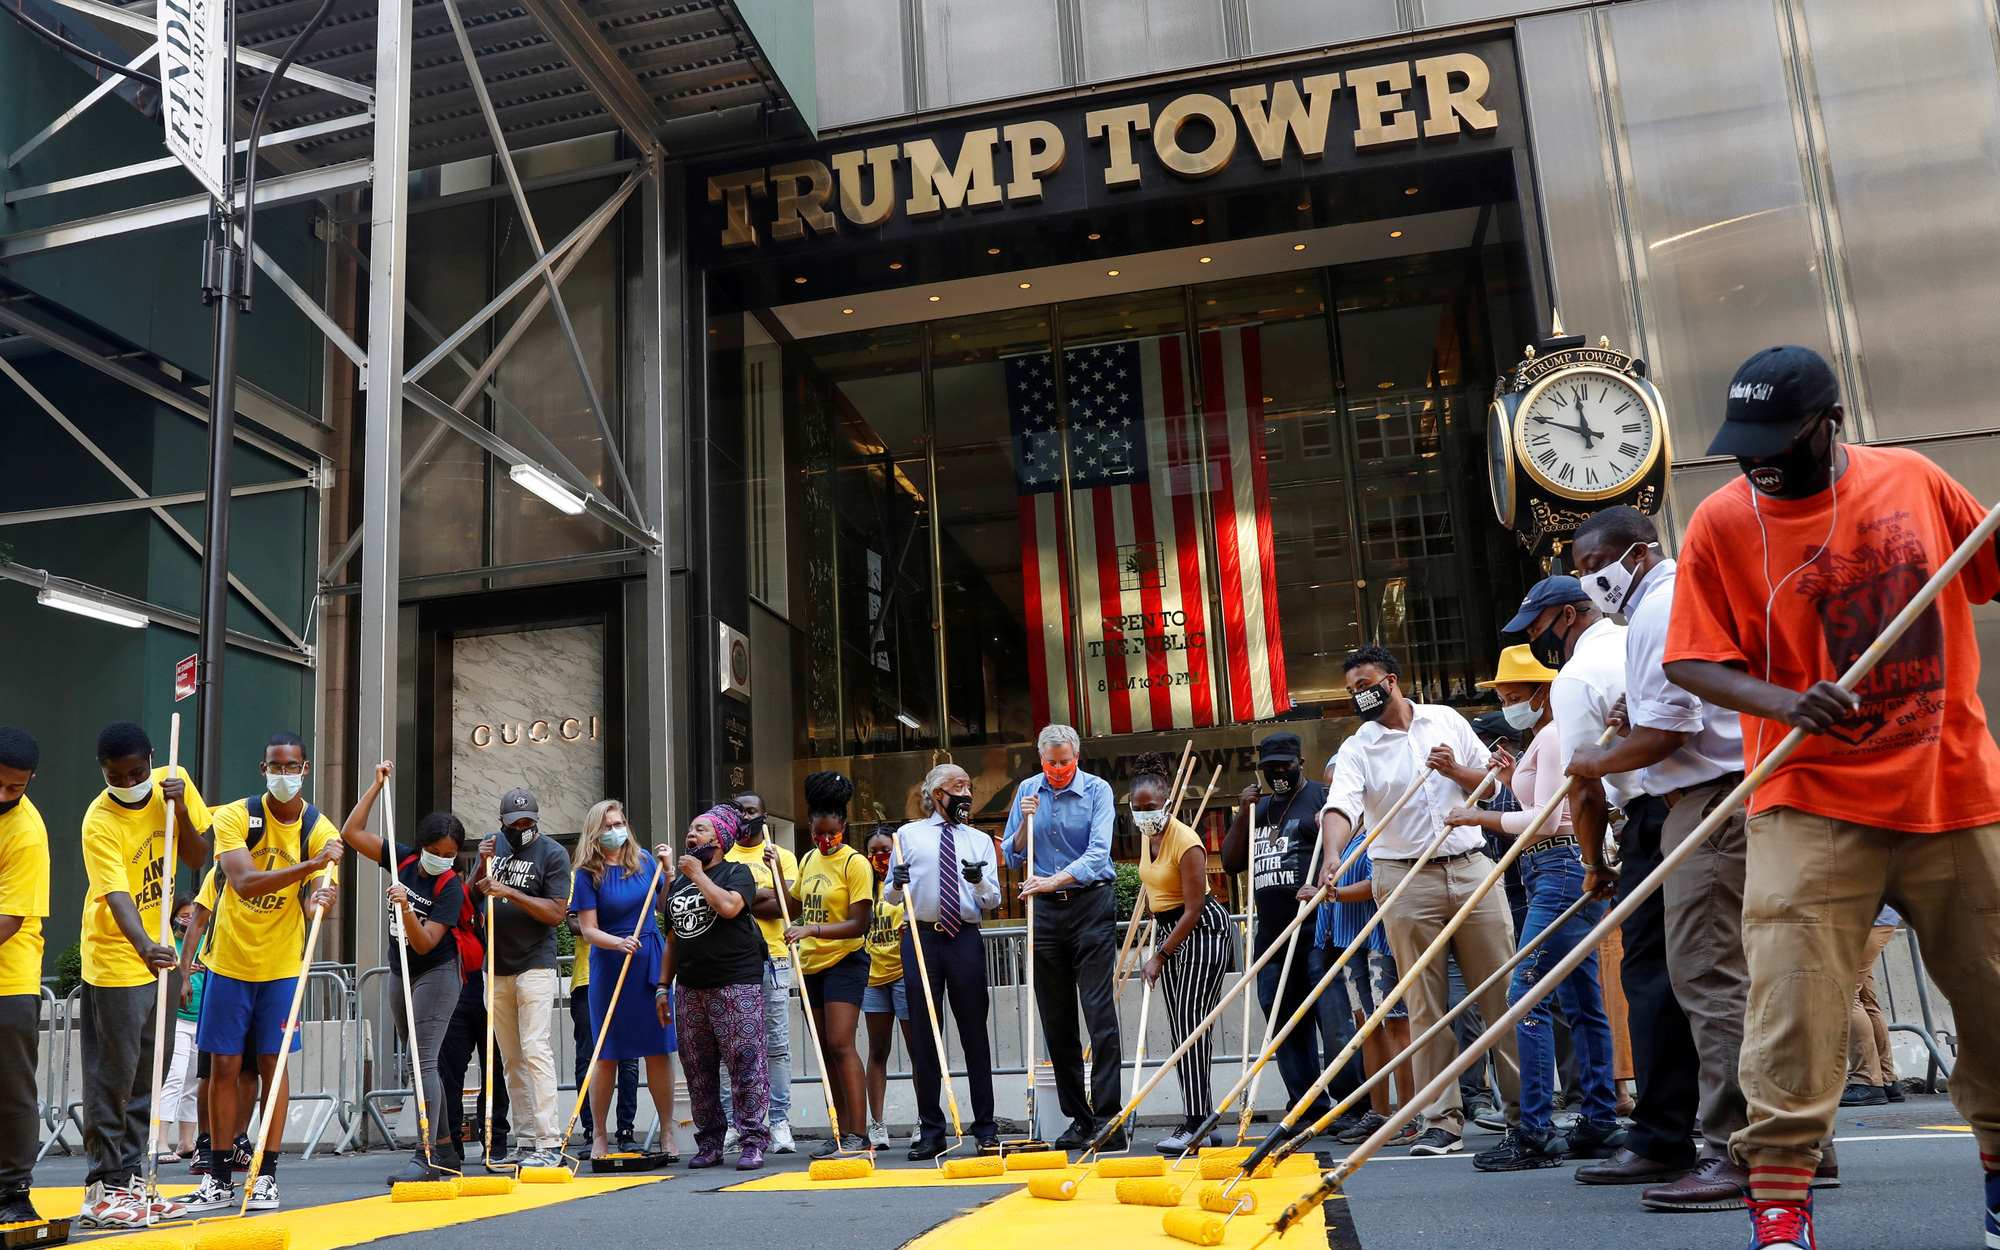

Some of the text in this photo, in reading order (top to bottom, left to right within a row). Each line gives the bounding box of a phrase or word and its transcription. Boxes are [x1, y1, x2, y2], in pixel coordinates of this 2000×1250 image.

[707, 53, 1498, 249] TRUMP TOWER
[1529, 351, 1621, 376] TRUMP TOWER
[1755, 475, 1780, 485] NAN
[1827, 571, 1919, 638] STOP
[1102, 610, 1188, 633] OPEN TO
[1088, 632, 1205, 658] THE PUBLIC
[1138, 677, 1153, 689] to
[1156, 674, 1173, 687] 10
[1175, 671, 1200, 686] PM
[1854, 656, 1942, 696] ELFISH
[1355, 690, 1371, 698] BLACK
[1360, 699, 1377, 708] MATTER
[1896, 700, 1945, 726] ENOUG
[471, 715, 597, 748] GUCCI
[1869, 728, 1931, 745] FOLLOW US
[1155, 746, 1263, 777] TOWE
[132, 846, 144, 864] STREET
[135, 877, 175, 910] PEA
[249, 893, 287, 910] ACE
[804, 894, 822, 909] AM
[804, 909, 829, 923] ACE
